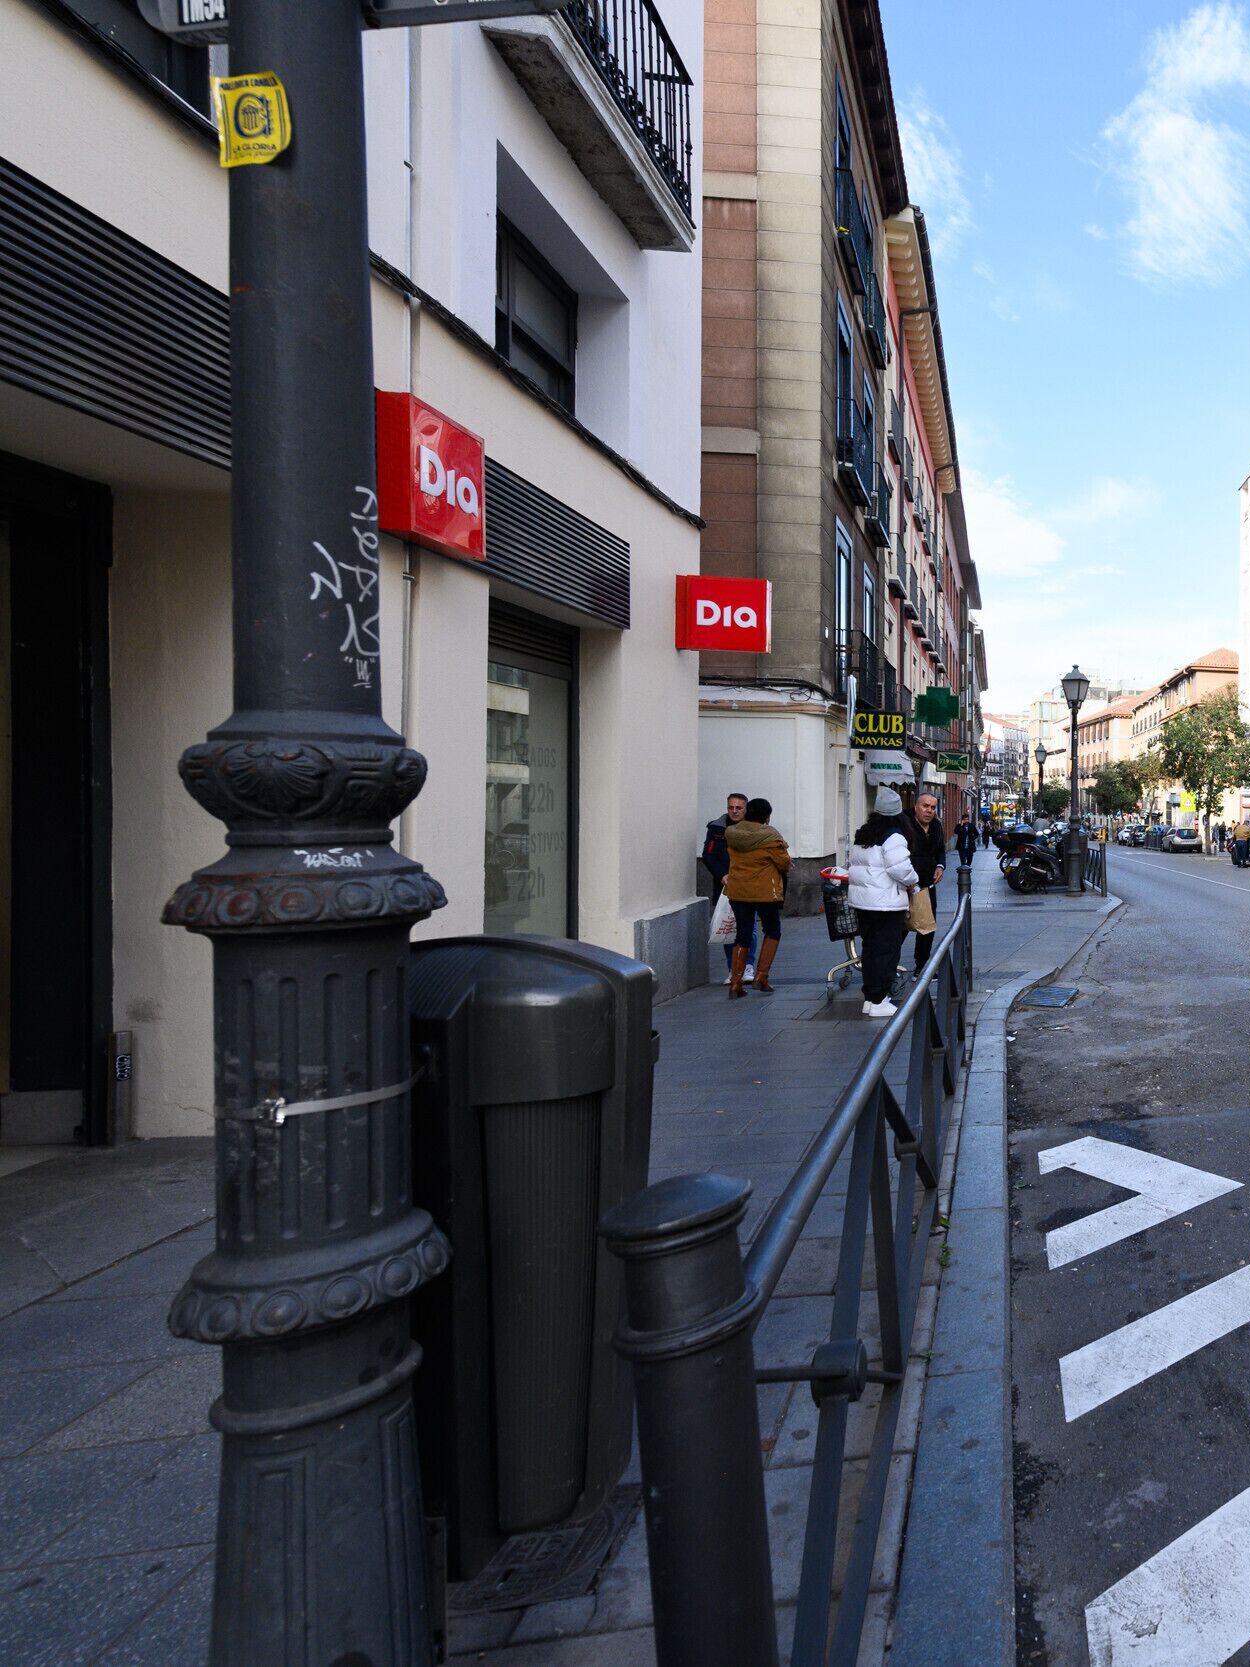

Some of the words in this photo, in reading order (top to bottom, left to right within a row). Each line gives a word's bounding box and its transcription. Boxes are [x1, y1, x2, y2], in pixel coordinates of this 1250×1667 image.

[421, 445, 479, 517] Dia
[696, 599, 758, 628] Dia
[854, 712, 904, 734] CLUB
[855, 736, 903, 747] NAYKAS
[529, 747, 557, 769] ADOS
[870, 762, 902, 770] NAYKAS
[529, 831, 566, 854] STIVOS
